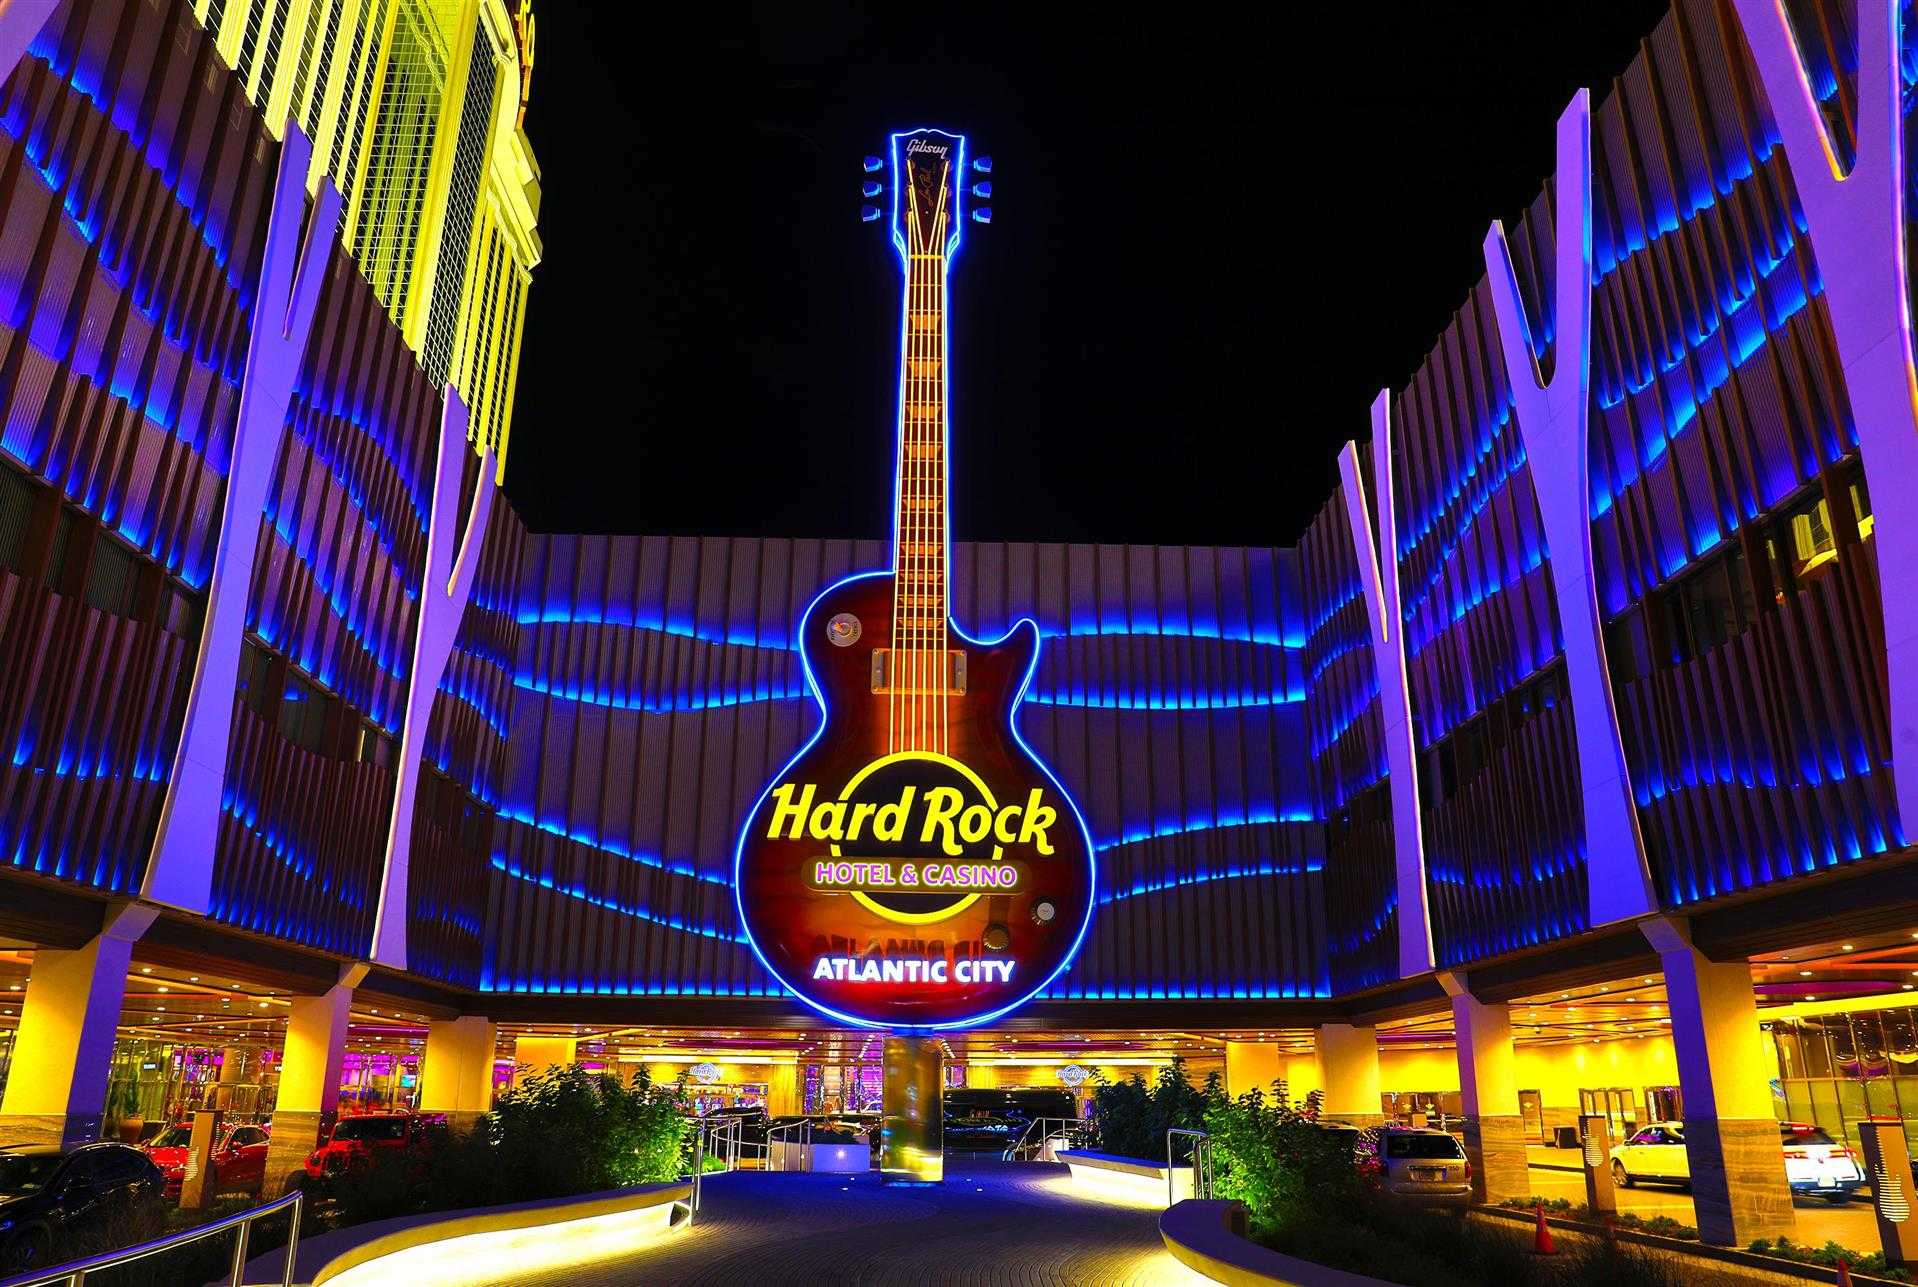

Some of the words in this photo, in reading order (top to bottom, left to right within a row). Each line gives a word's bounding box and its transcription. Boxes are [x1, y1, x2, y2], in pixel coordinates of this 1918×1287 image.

[906, 138, 948, 160] Gibson
[766, 783, 917, 841] Hard
[920, 786, 1057, 856] Rock
[815, 862, 895, 885] HOTEL
[900, 864, 920, 886] &
[923, 864, 1018, 887] CASINO
[813, 957, 948, 984] ATLANTIC
[954, 960, 1016, 983] CITY
